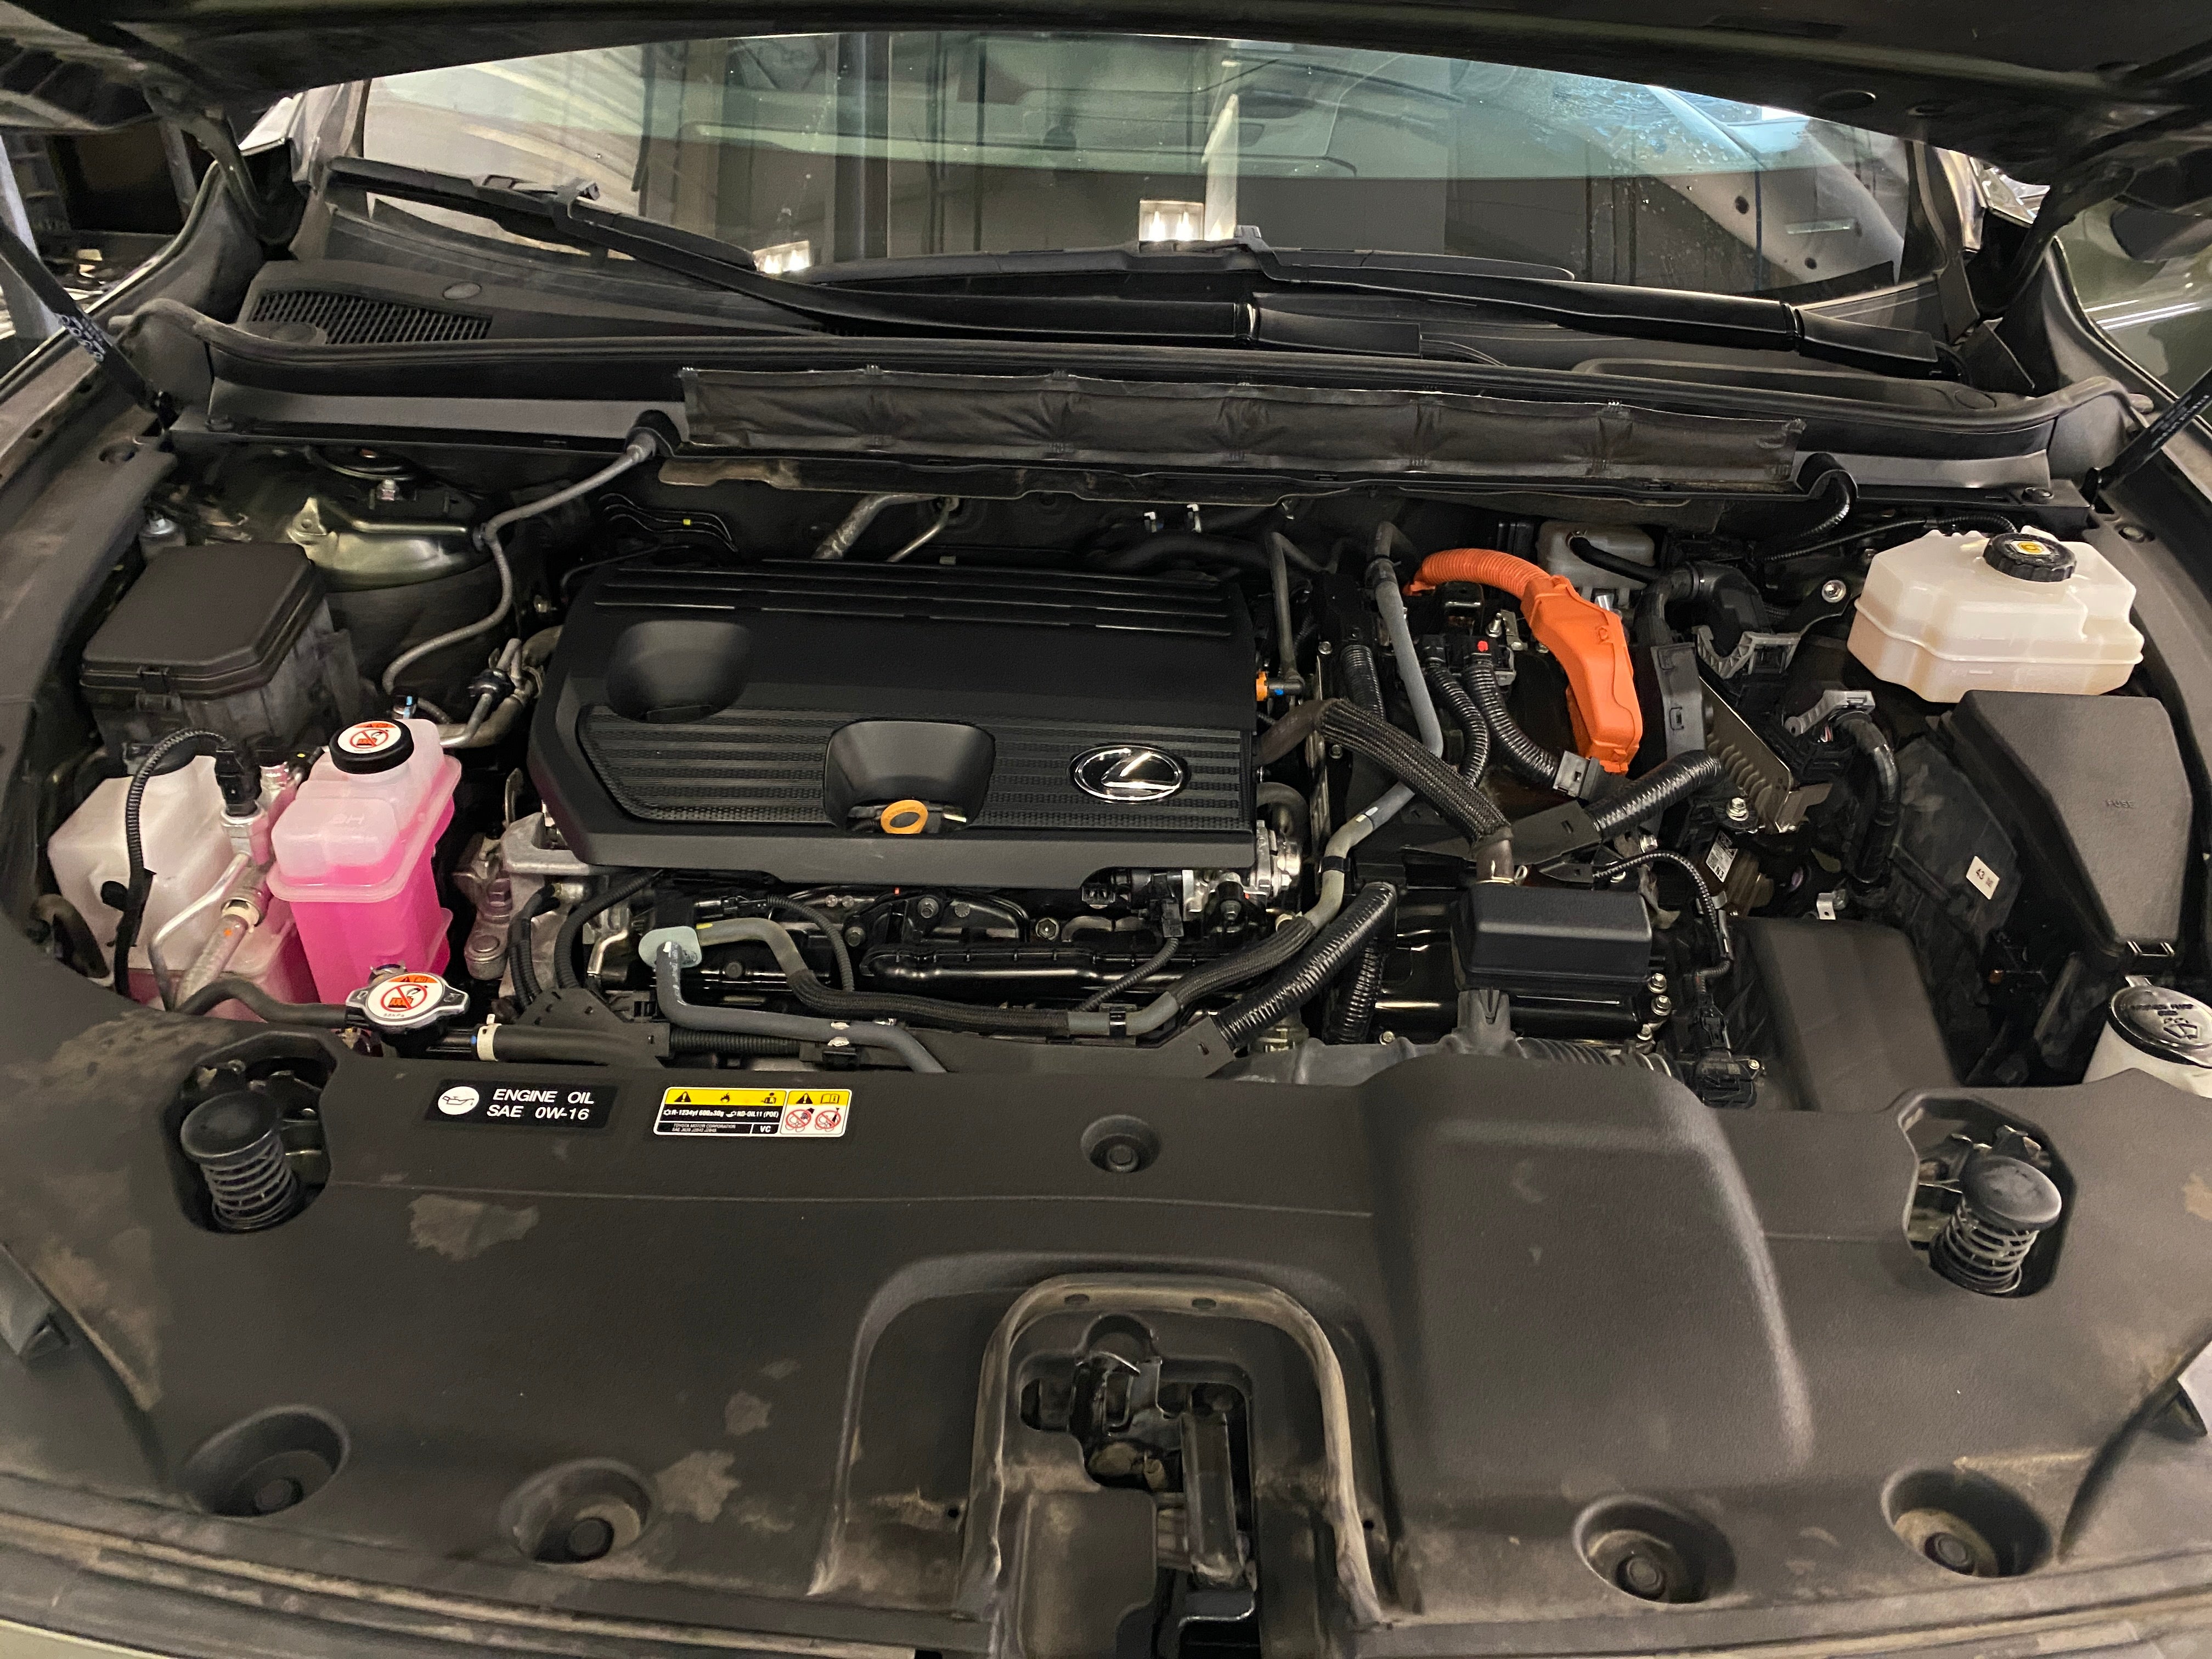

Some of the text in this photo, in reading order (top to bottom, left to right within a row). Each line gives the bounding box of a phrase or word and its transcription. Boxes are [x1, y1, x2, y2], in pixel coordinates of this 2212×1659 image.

[493, 1088, 595, 1104] ENGINE OIL
[487, 1105, 590, 1120] SAE 0W-16
